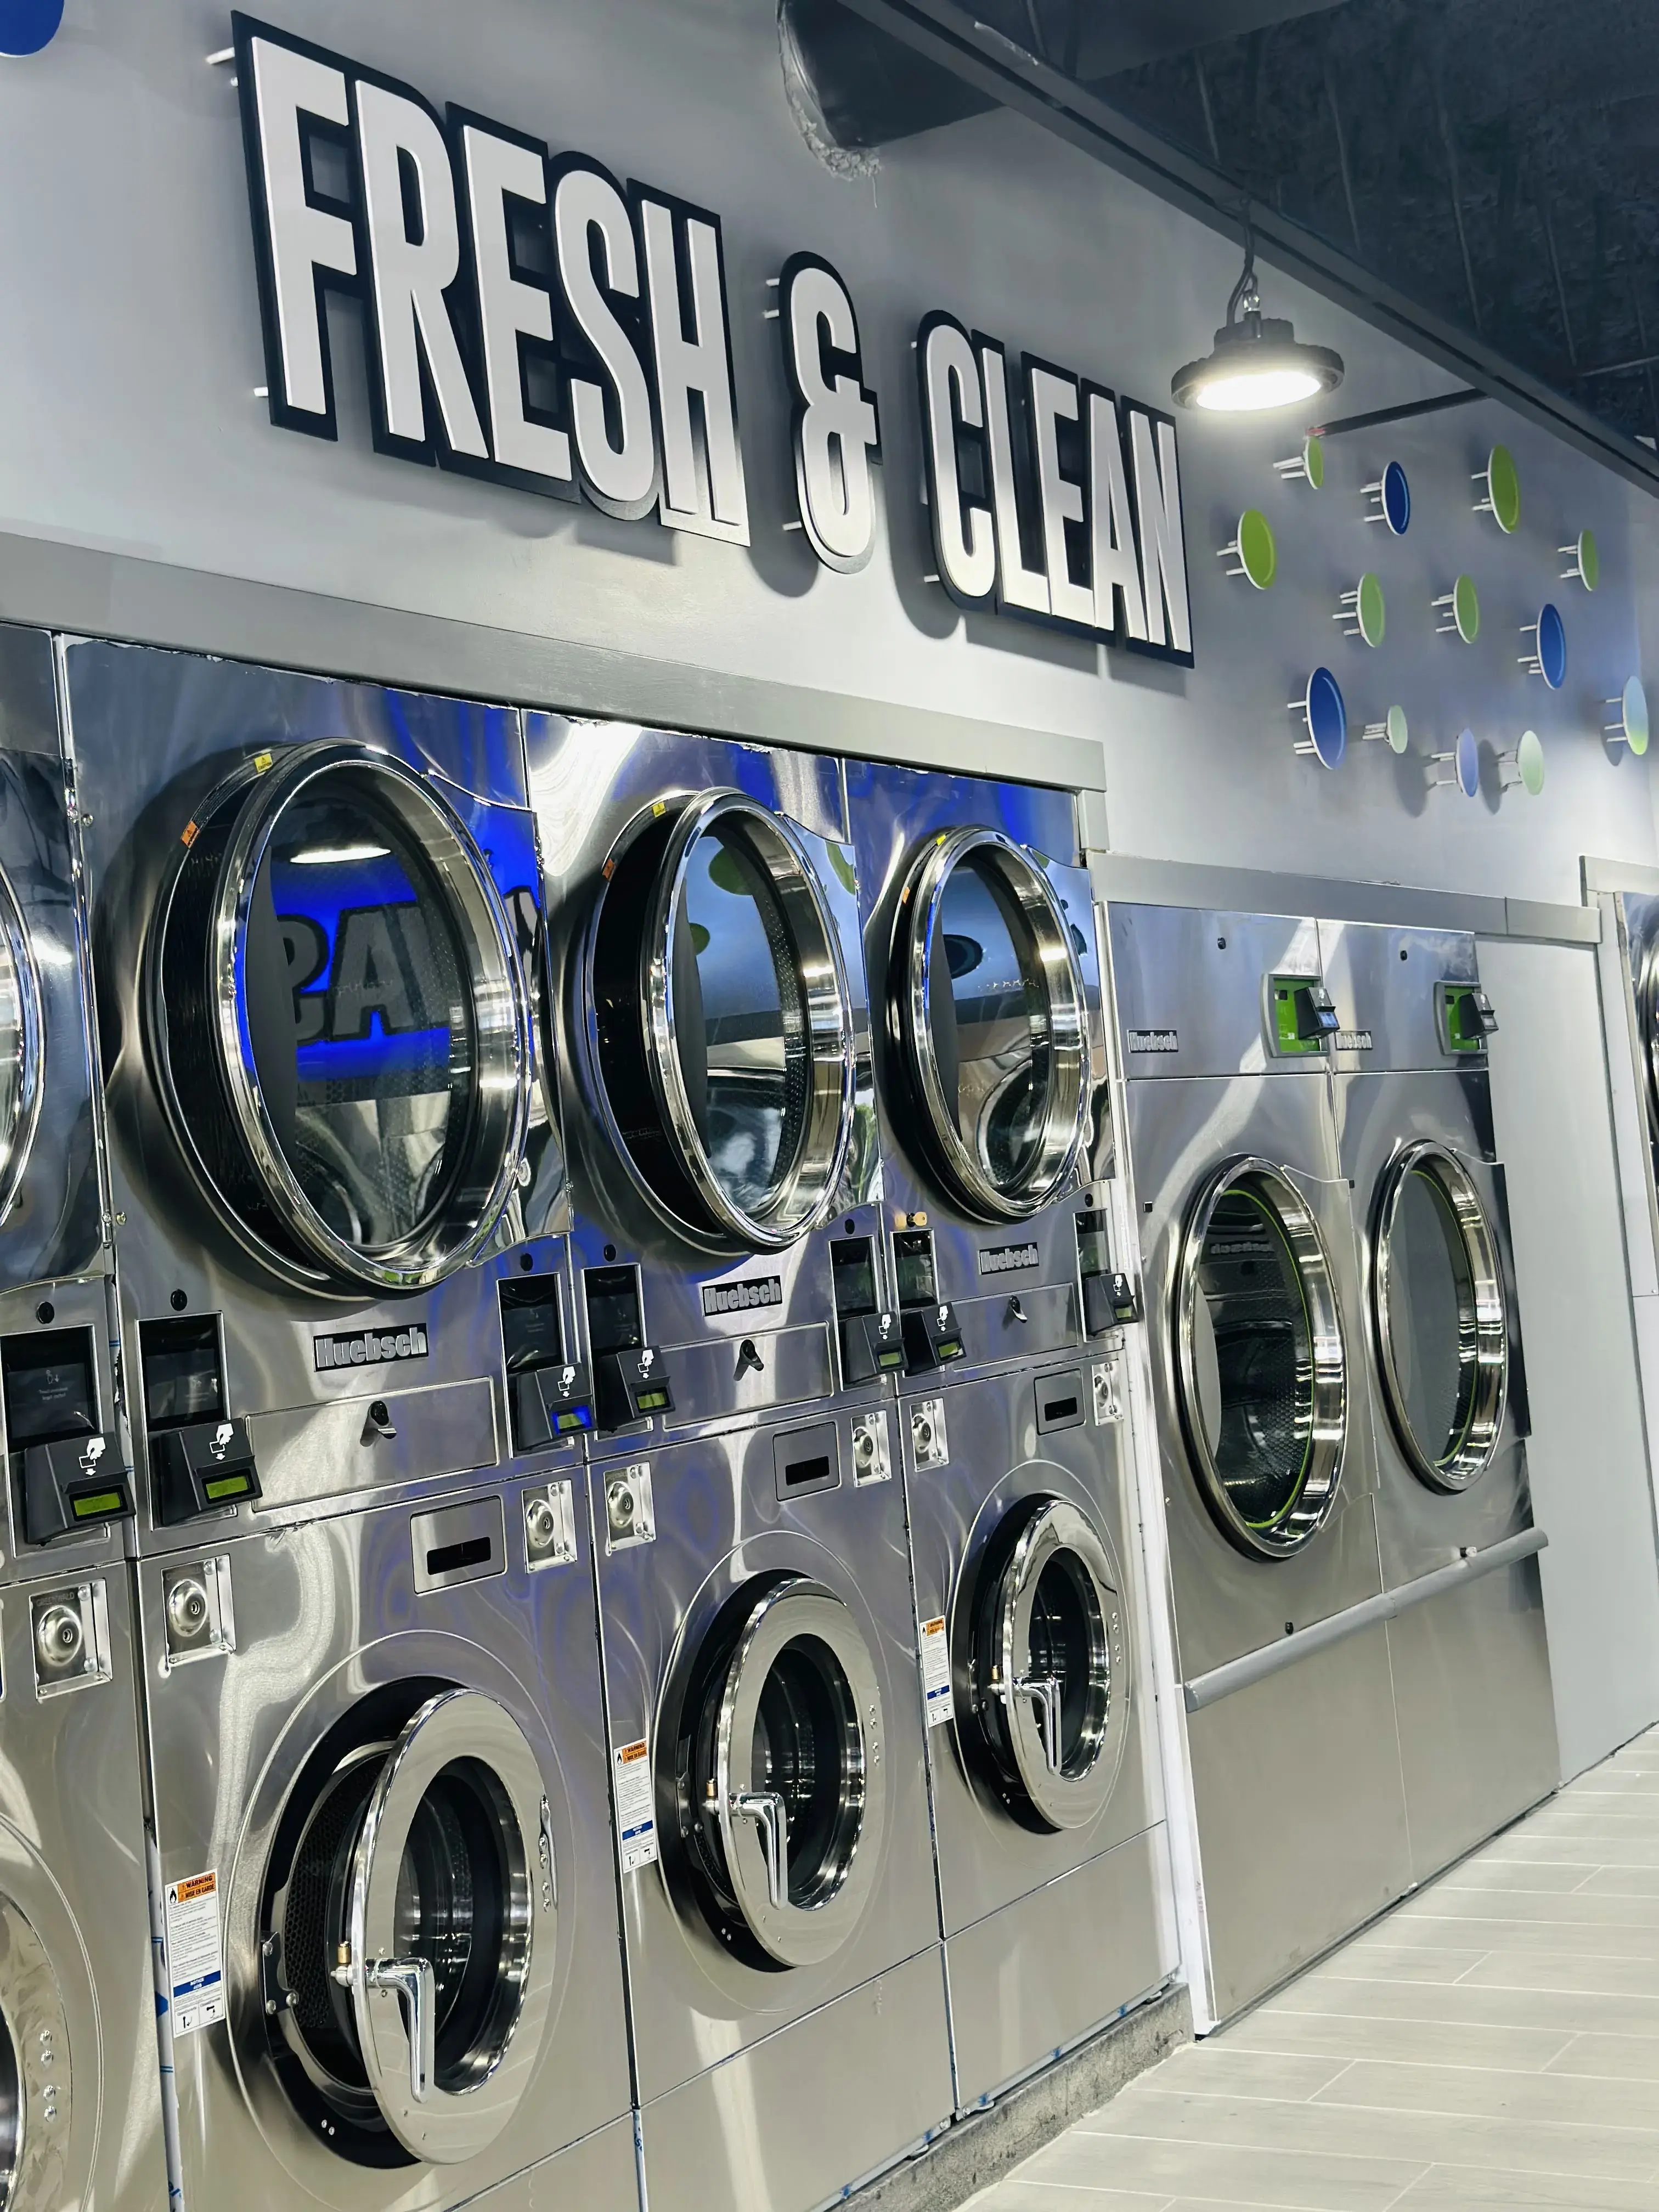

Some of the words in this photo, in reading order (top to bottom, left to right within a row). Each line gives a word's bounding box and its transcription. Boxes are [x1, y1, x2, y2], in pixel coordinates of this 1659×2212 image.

[235, 16, 752, 546] FRESH
[780, 252, 881, 574] &
[918, 311, 1194, 668] CLEAN
[1129, 1031, 1178, 1051] Huebsch
[980, 1244, 1037, 1272] Huebsch
[704, 1278, 781, 1313] Huebsch
[315, 1327, 427, 1368] Huebsch
[185, 1875, 213, 1889] WARNING
